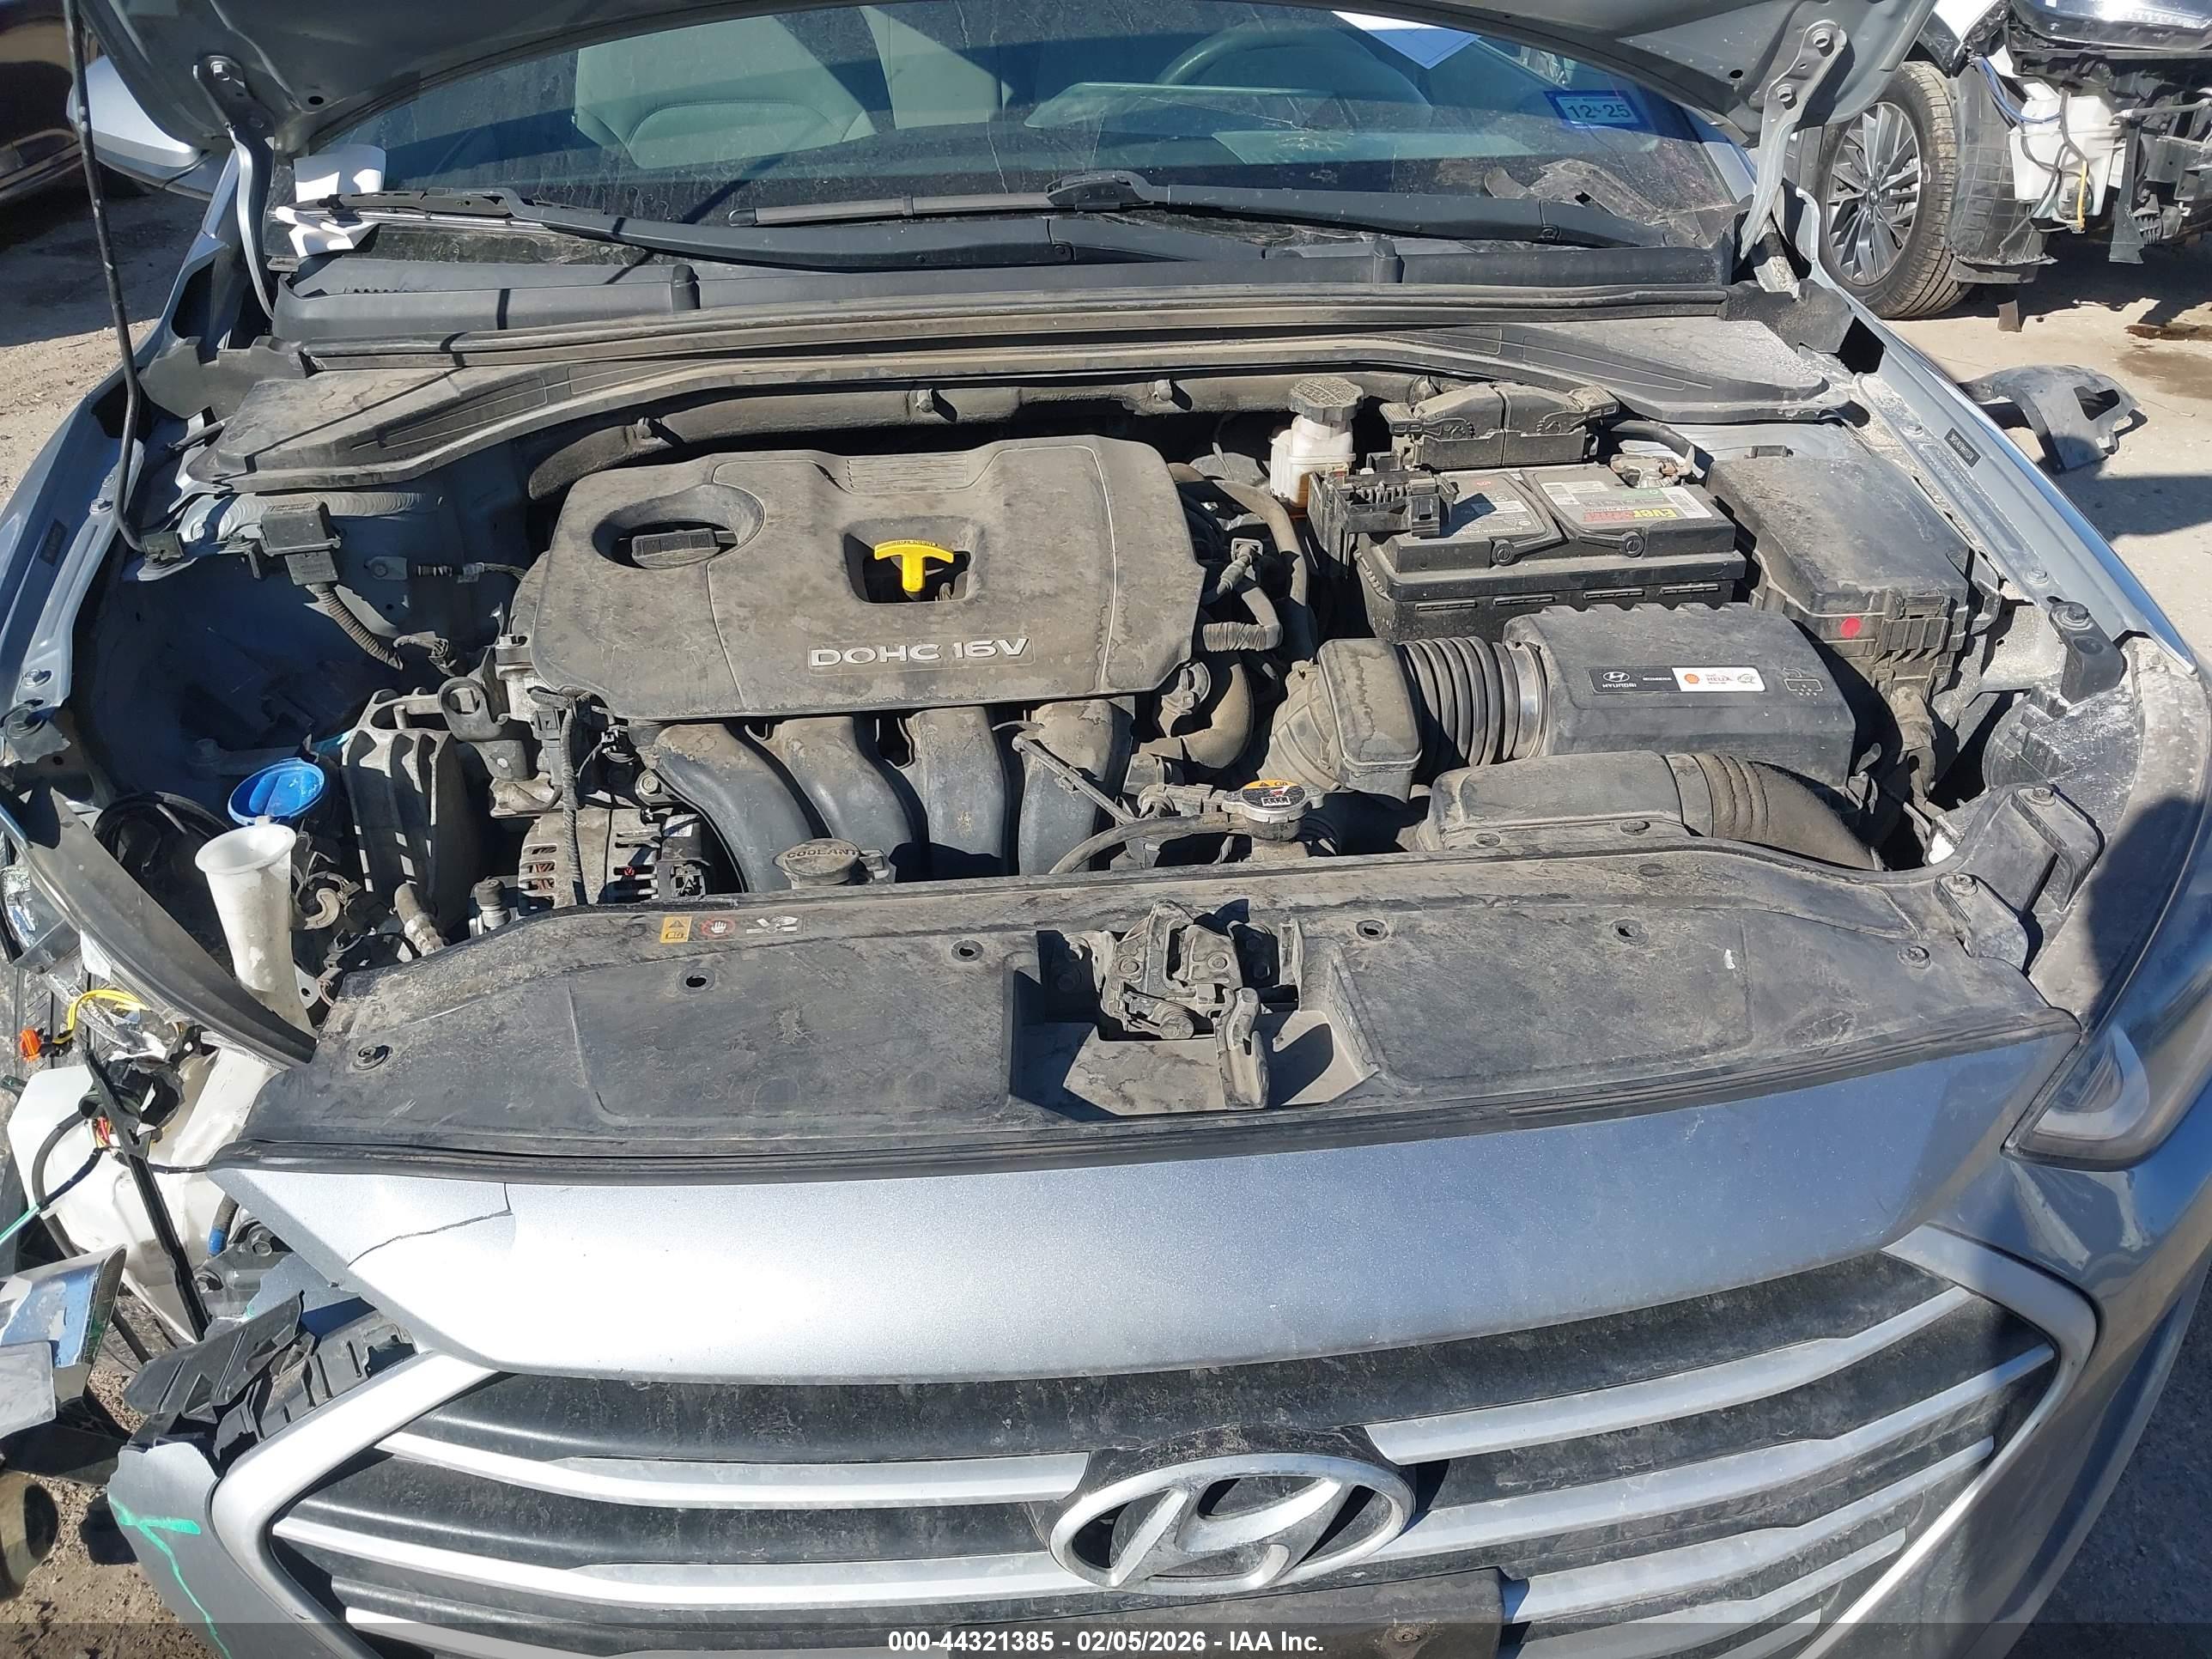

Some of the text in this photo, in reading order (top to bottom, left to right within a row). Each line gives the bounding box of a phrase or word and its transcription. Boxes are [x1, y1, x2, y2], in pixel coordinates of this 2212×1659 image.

[811, 639, 1029, 666] DOHC 16V
[787, 848, 857, 858] COOLANT
